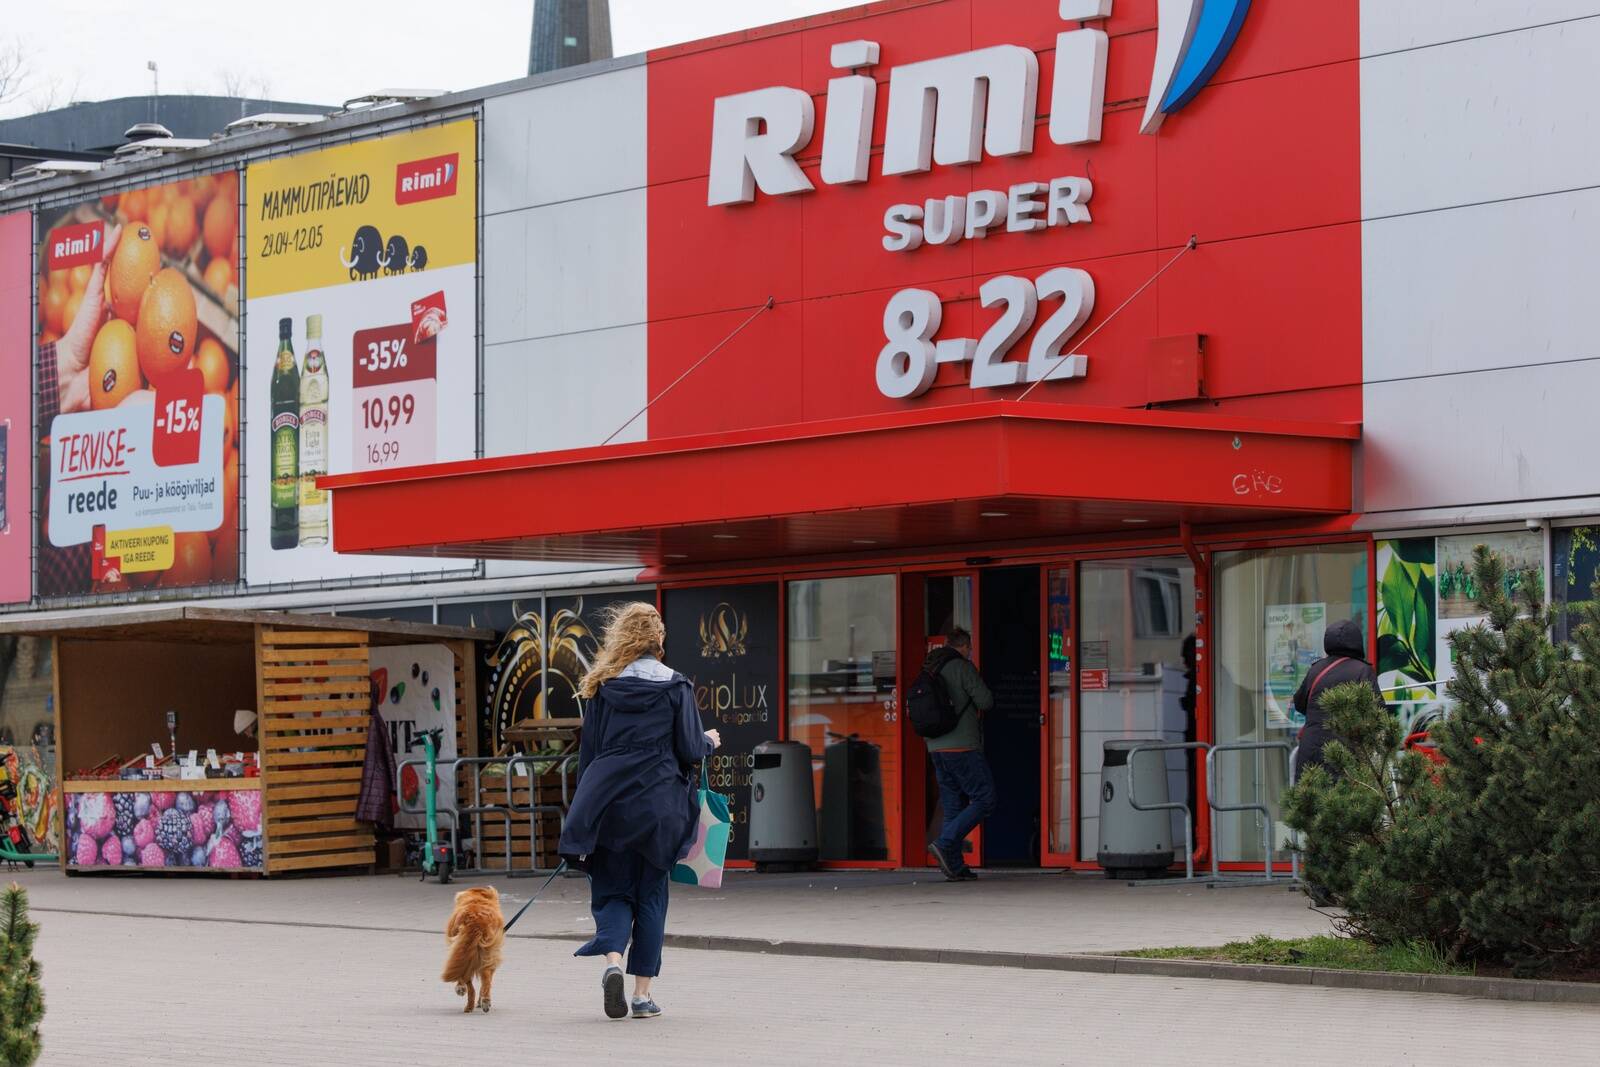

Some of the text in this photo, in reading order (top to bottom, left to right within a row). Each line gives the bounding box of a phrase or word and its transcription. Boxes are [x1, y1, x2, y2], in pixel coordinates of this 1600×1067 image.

[708, 0, 1112, 206] Rimi
[261, 173, 370, 221] MAMMUTIPÄEVAD
[401, 167, 442, 193] Rimi
[882, 176, 1094, 252] SUPER
[55, 233, 90, 258] Rimi
[261, 224, 323, 258] 29.04-12.05
[875, 267, 1096, 399] 8-22
[359, 338, 408, 372] -35%
[157, 399, 199, 435] -15%
[362, 393, 415, 434] 10,99
[59, 428, 136, 474] TERVISE-
[367, 440, 400, 465] 16,99
[68, 480, 118, 514] reede
[132, 477, 215, 502] Puu- ja köögiviljad
[110, 537, 143, 550] AKTIVEERI
[143, 534, 169, 547] KUPONG
[134, 551, 156, 562] REEDE
